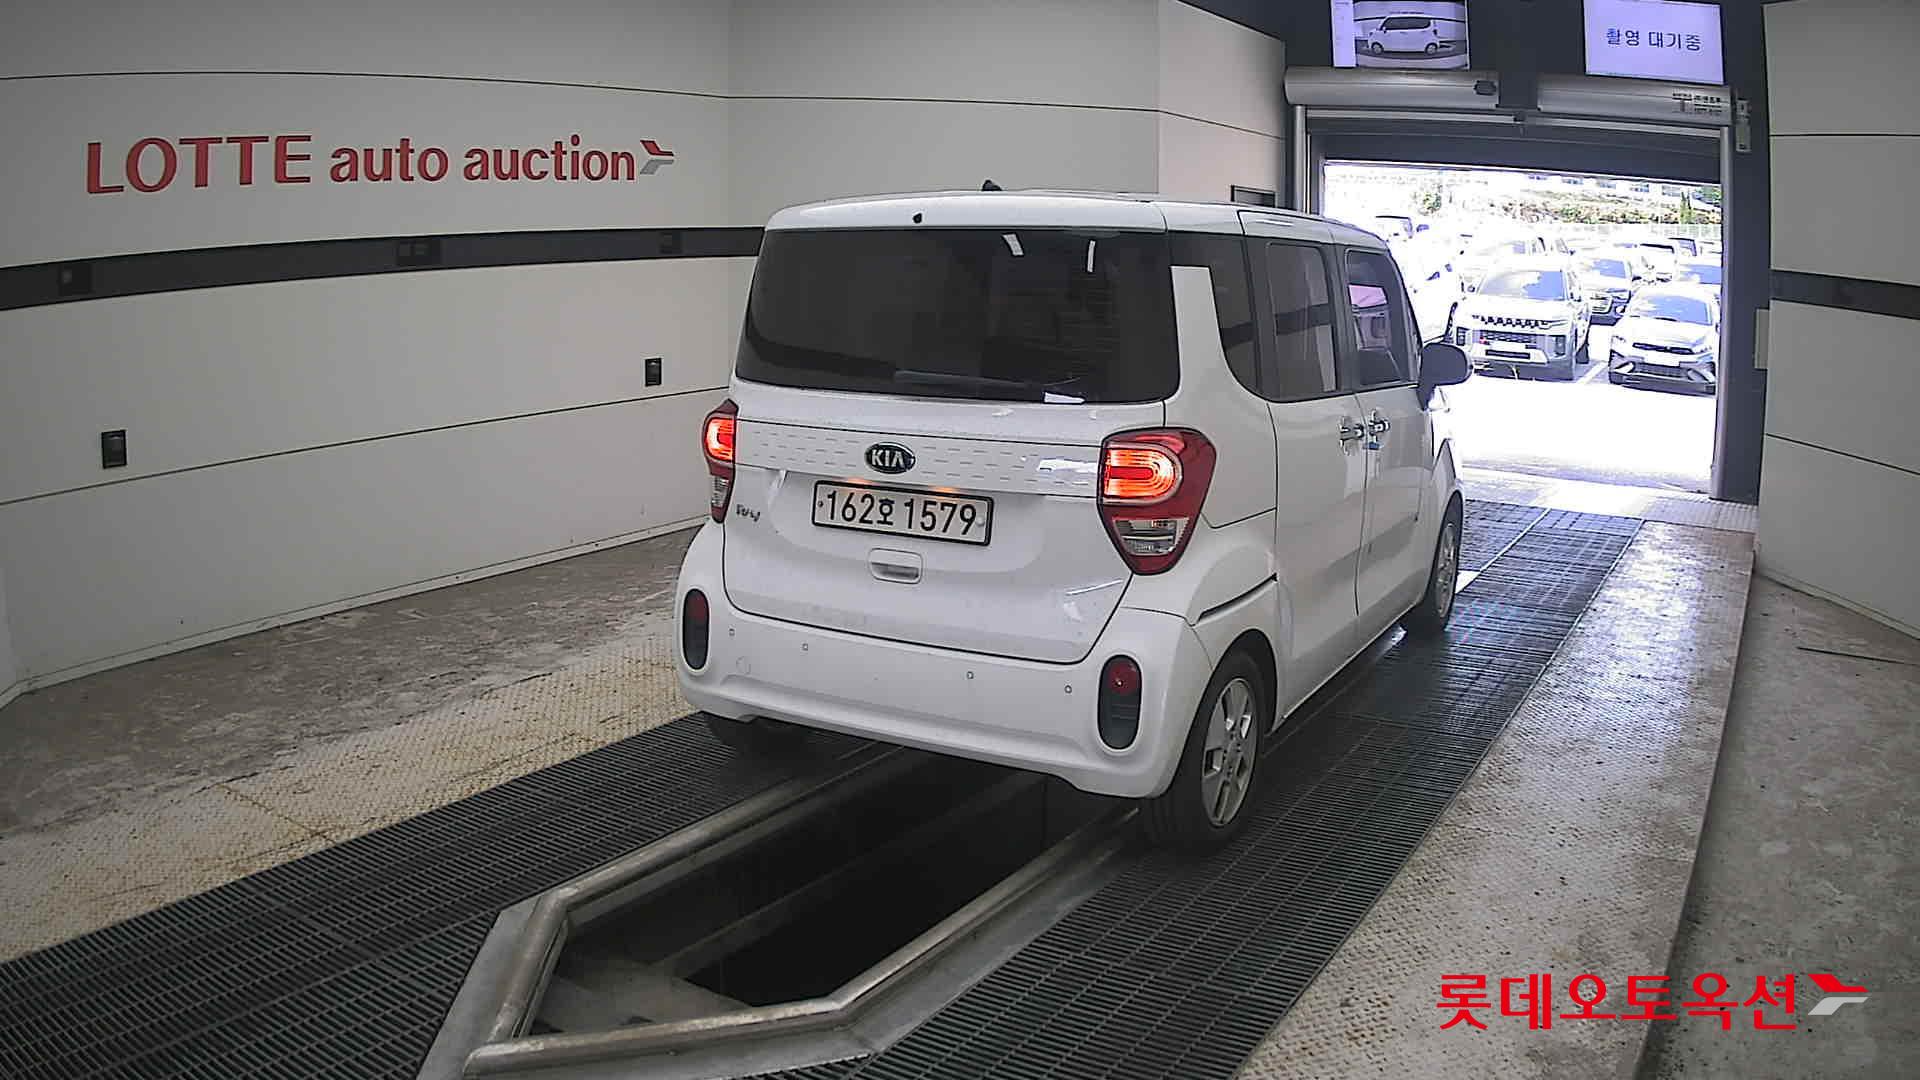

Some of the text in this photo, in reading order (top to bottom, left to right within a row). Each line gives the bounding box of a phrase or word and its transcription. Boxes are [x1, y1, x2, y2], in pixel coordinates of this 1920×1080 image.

[1648, 31, 1701, 51] 대기중
[87, 134, 635, 194] LOTTE auto auction
[871, 449, 905, 467] KIA
